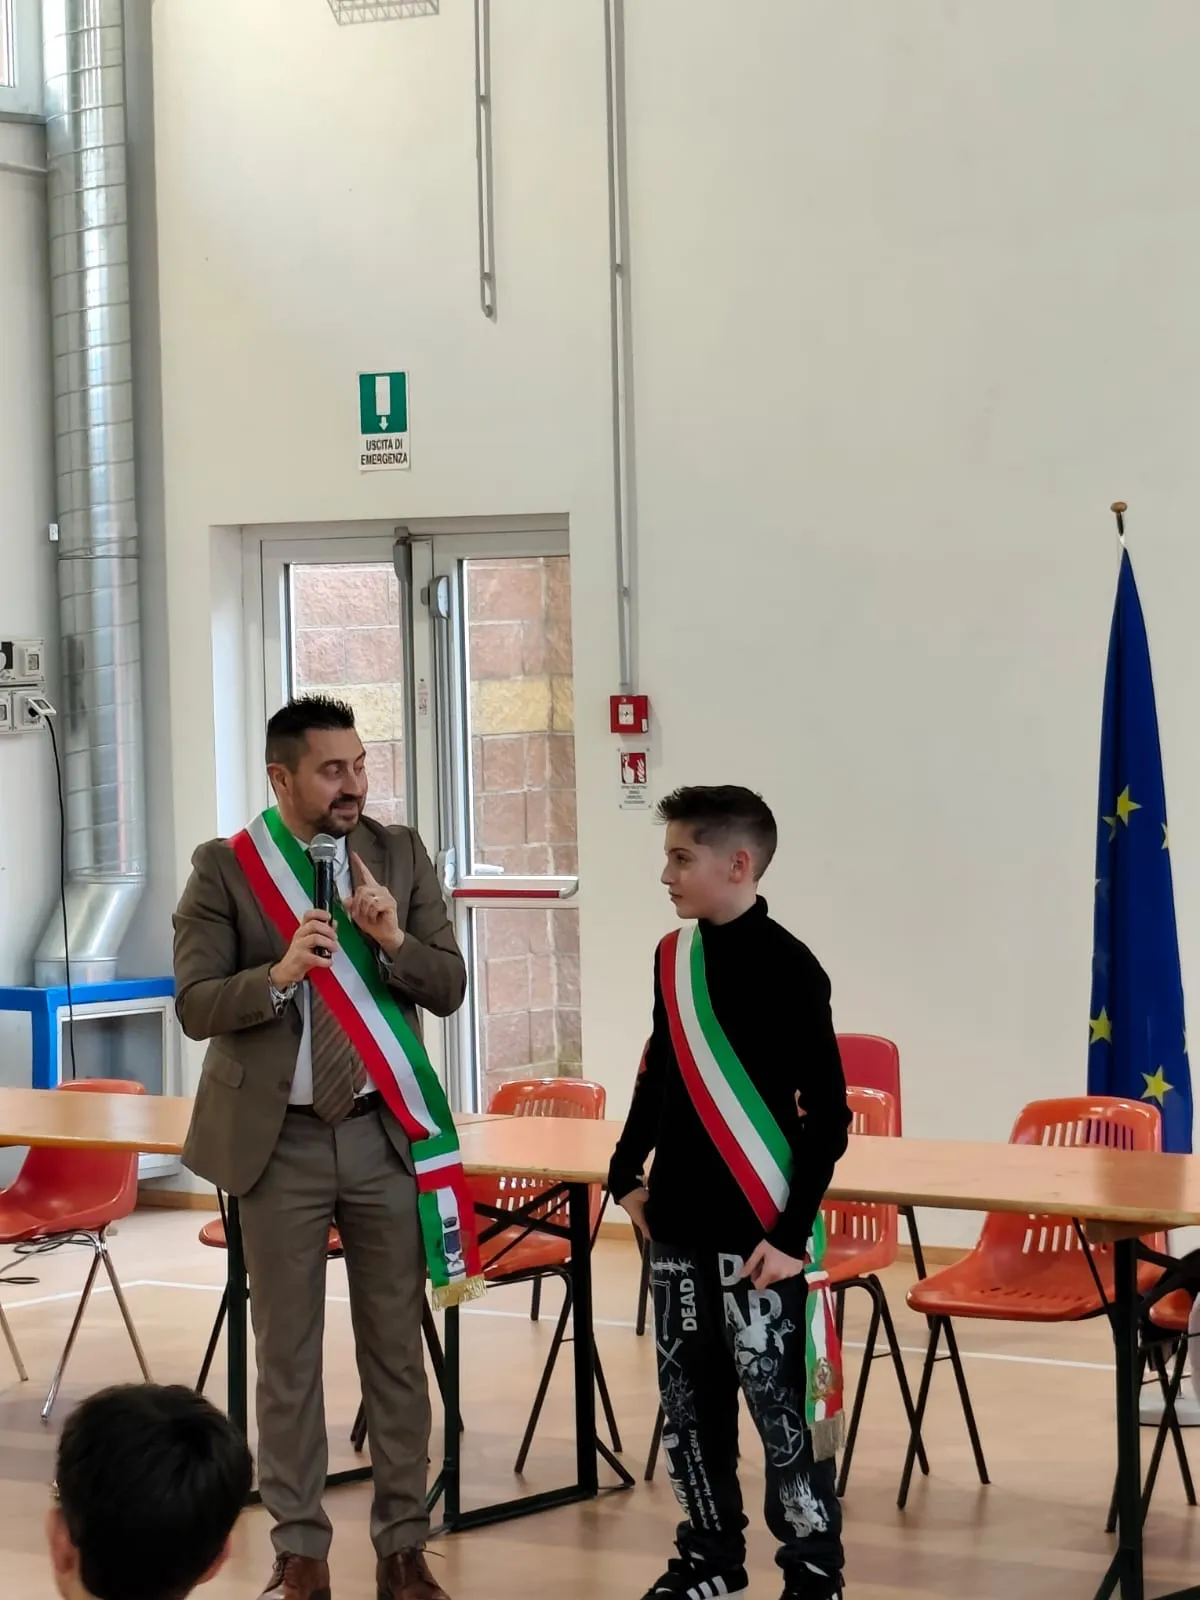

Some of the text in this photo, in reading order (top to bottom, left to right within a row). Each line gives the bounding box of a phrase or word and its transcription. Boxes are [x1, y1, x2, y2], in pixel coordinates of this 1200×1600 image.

[366, 438, 402, 451] USCITA DI
[361, 453, 408, 465] EMERGENZA
[680, 1278, 697, 1331] DEAD
